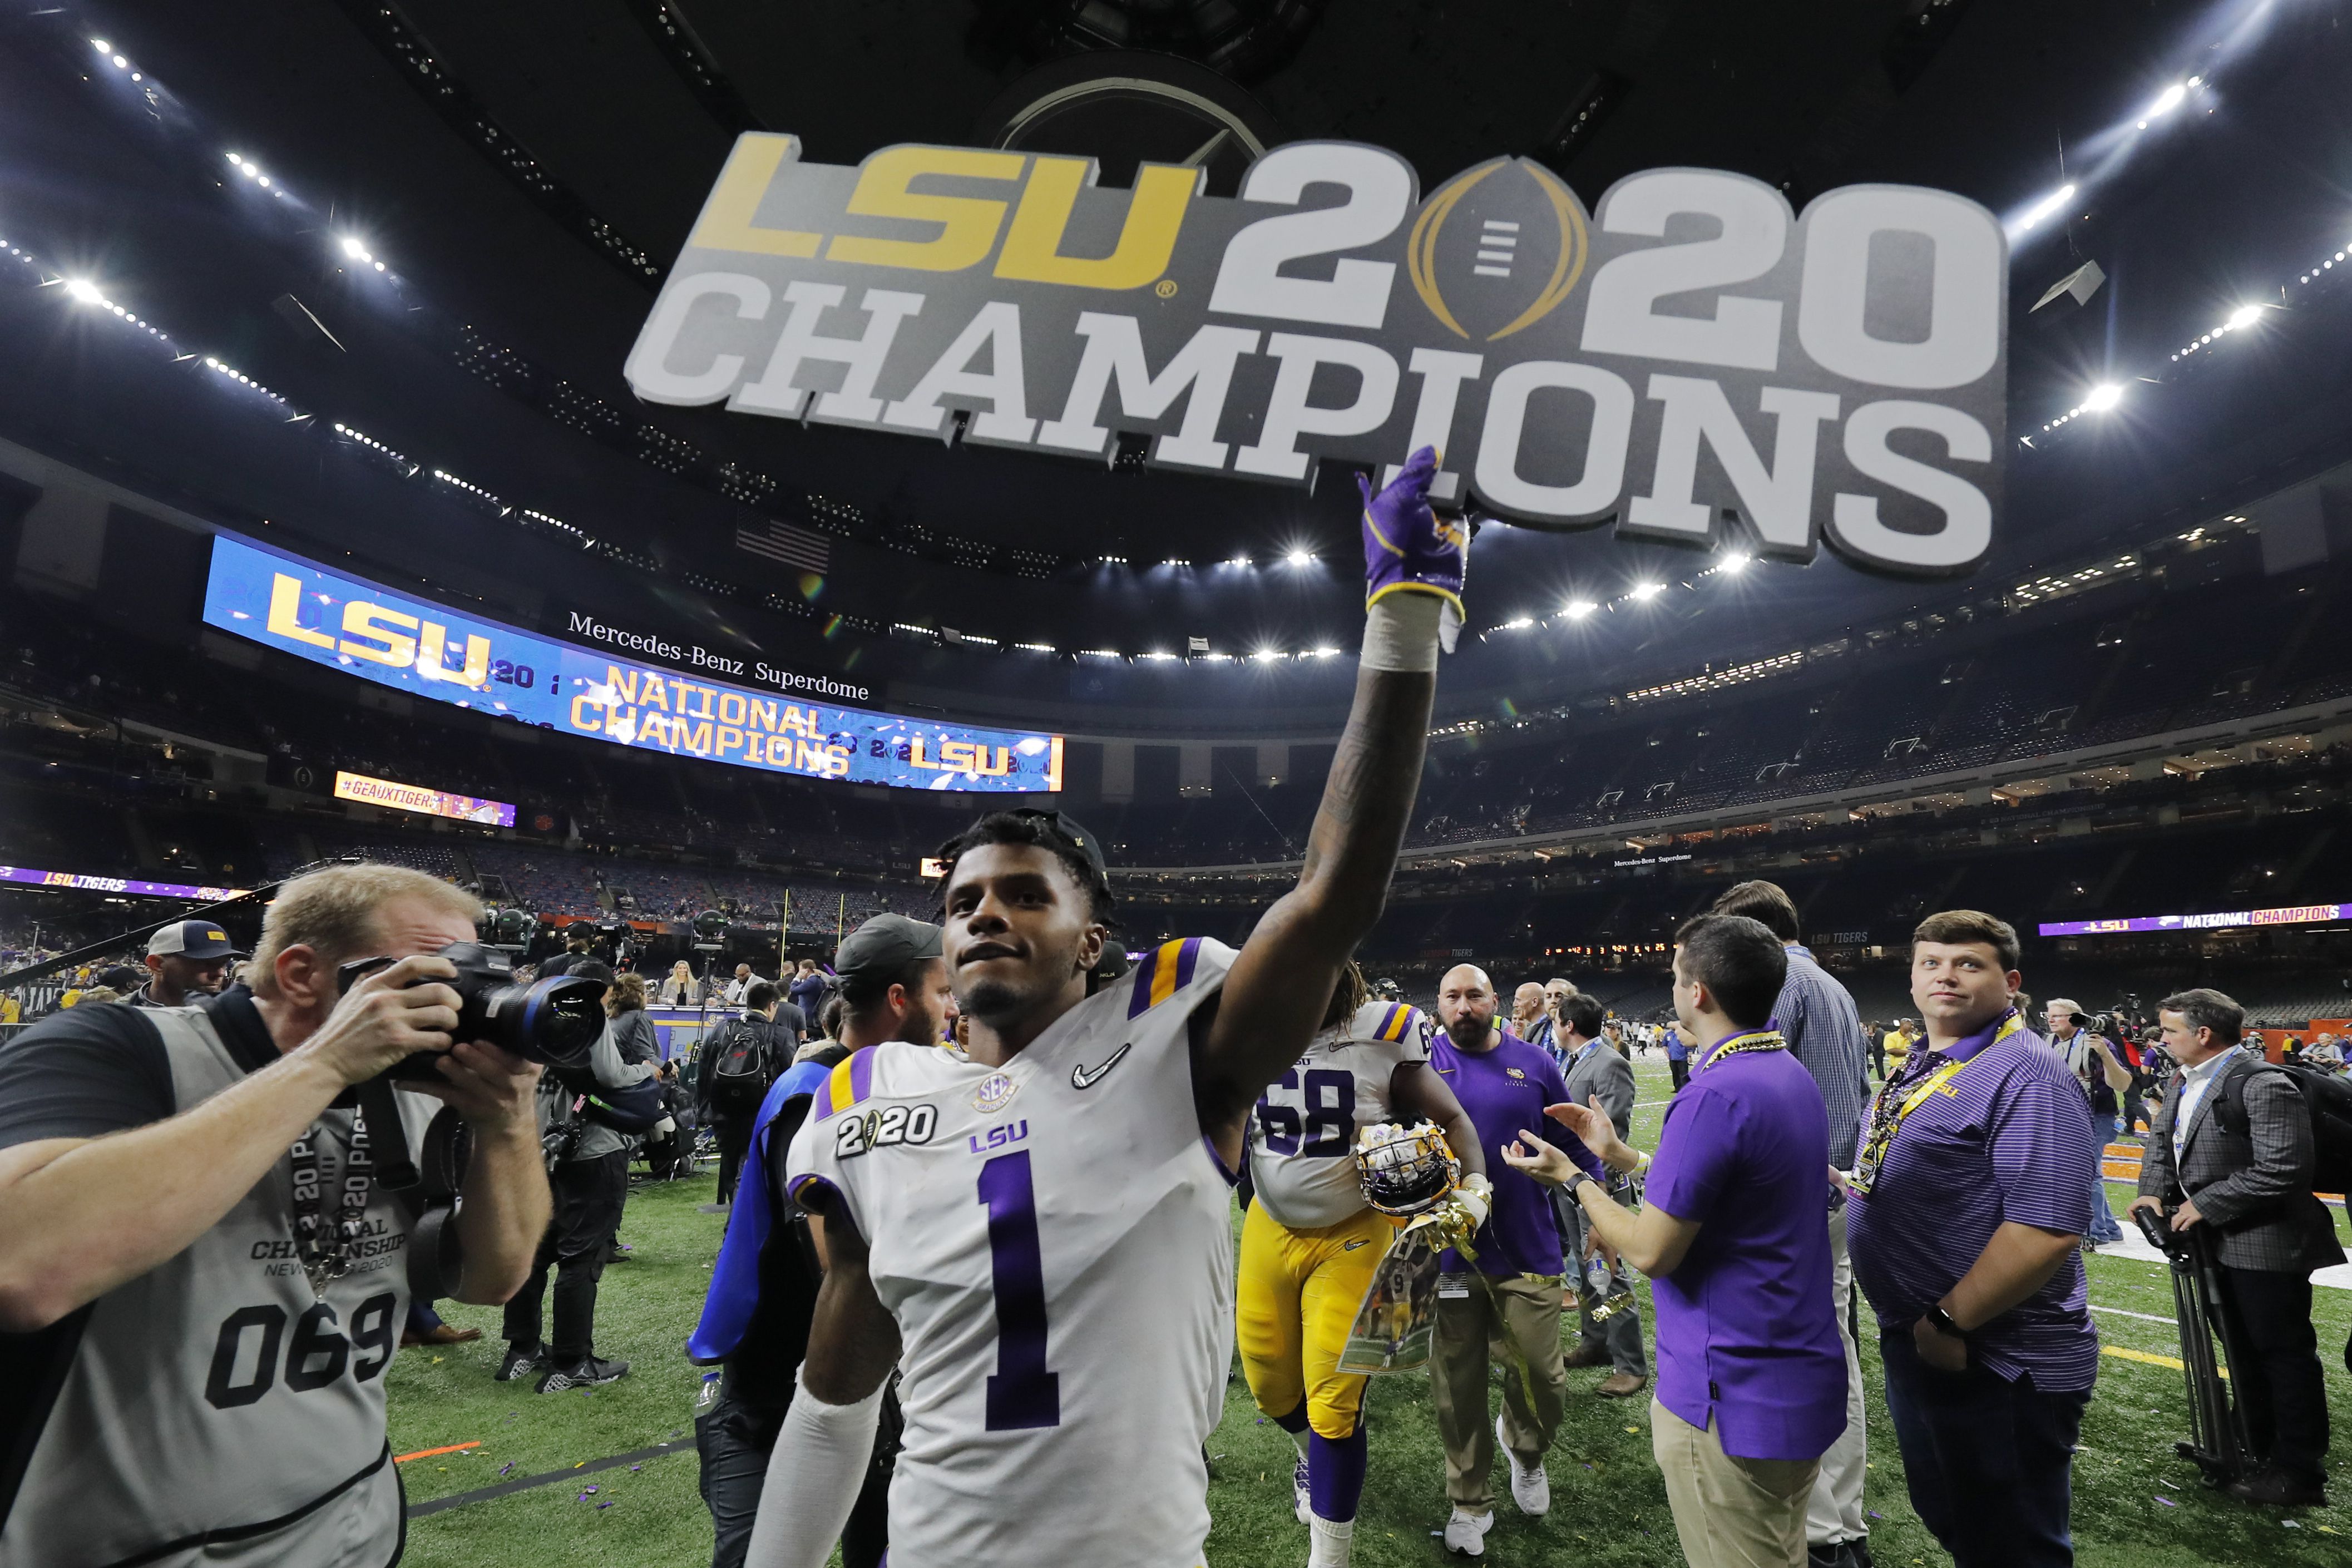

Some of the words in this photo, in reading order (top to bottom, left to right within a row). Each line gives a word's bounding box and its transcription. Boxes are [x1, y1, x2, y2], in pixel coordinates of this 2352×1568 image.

[690, 137, 1199, 290] LSU
[632, 272, 1993, 566] CHAMPIONS
[267, 572, 491, 687] LSU
[569, 611, 744, 676] Mercedes-Benz
[754, 662, 869, 701] Superdome
[606, 664, 827, 741] NATIONAL
[570, 694, 851, 776] CHAMPIONS
[910, 736, 1010, 776] LSU
[342, 779, 439, 808] #GEAUXTIGERS
[1614, 857, 1656, 867] Mercedes-Benz
[1658, 854, 1692, 863] Superdome
[45, 871, 77, 886] LSU
[77, 874, 126, 892] TIGERS
[1811, 934, 1830, 944] LSU
[1834, 932, 1868, 944] TIGERS
[2089, 919, 2131, 933] LSU
[2183, 911, 2251, 929] NATIONAL
[2252, 904, 2340, 924] CHAMPIONS
[1451, 948, 1473, 957] TIGERS
[979, 1074, 1010, 1102] SEC
[1255, 1067, 1356, 1158] 68
[969, 1119, 1028, 1154] LSU
[359, 1255, 392, 1273] 2020
[977, 1149, 1060, 1432] 1
[204, 1292, 396, 1410] 069
